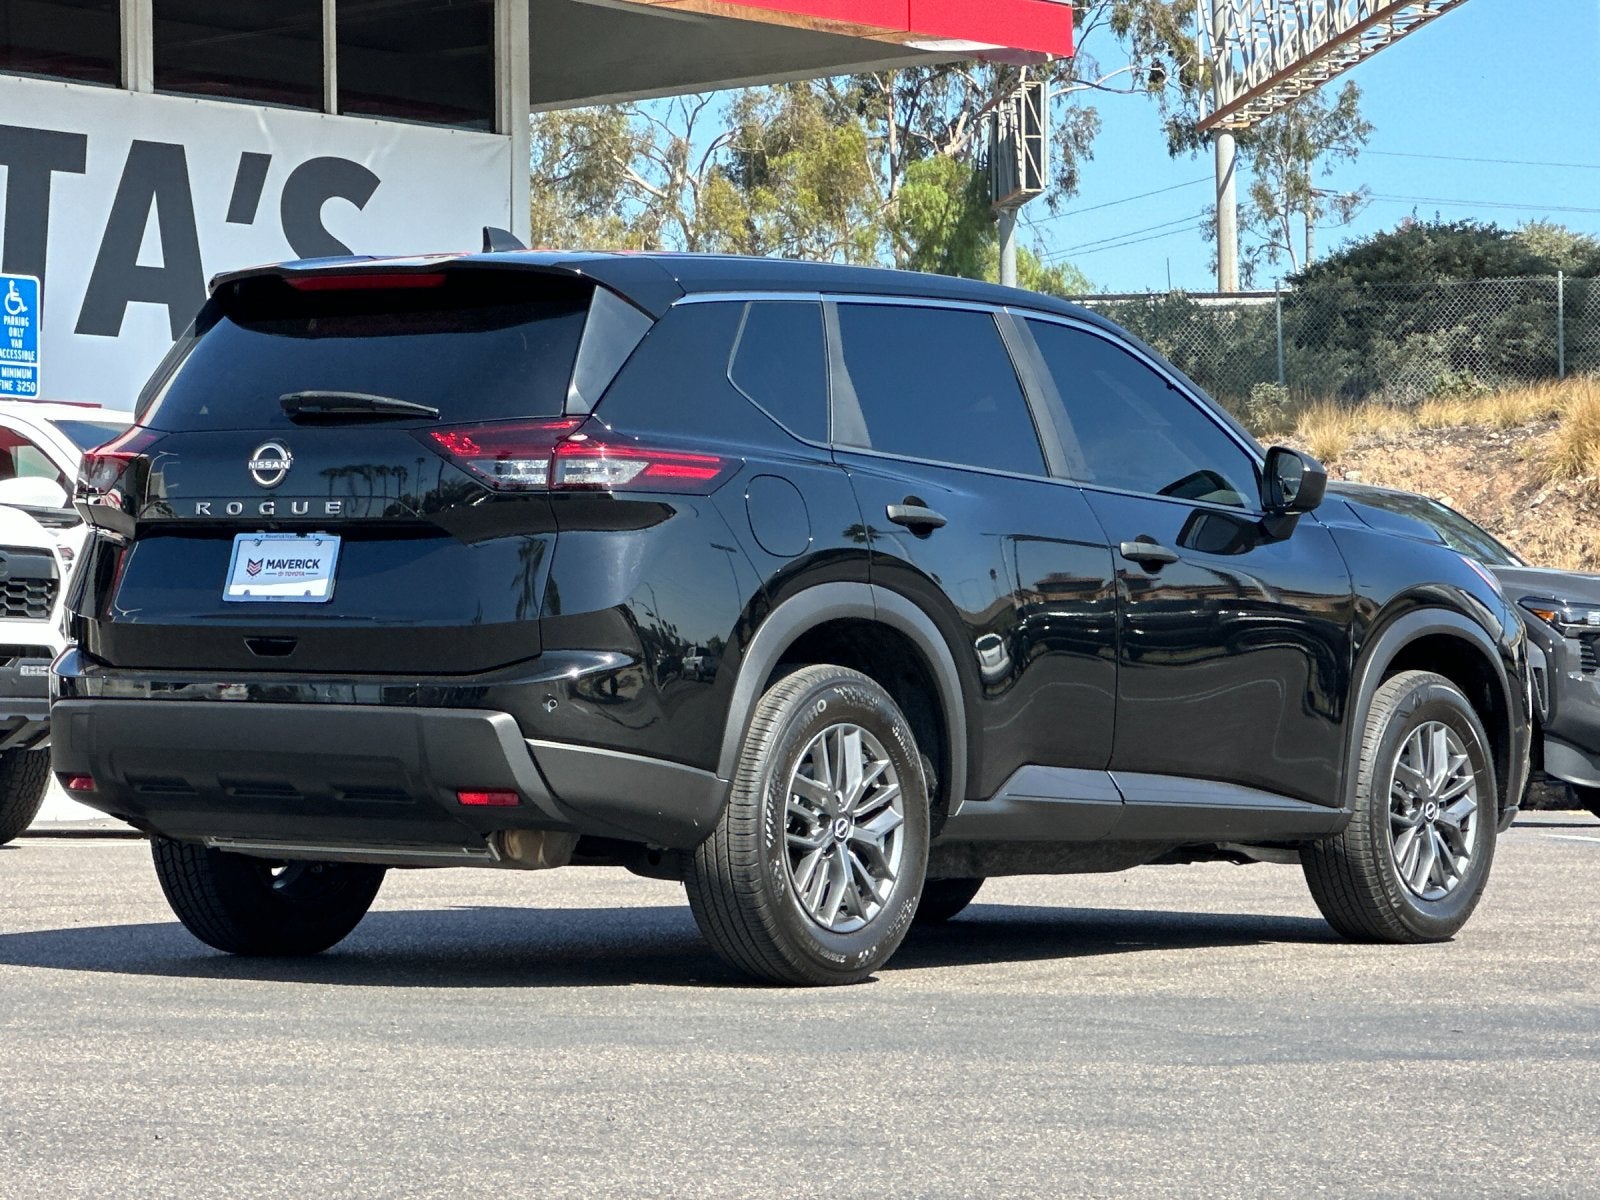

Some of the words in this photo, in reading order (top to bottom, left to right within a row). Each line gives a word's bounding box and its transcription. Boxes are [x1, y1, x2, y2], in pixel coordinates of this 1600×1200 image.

[3, 315, 29, 327] PARKING
[8, 327, 24, 338] ONLY
[11, 338, 23, 349] VAN
[1, 366, 32, 379] MINIMUM
[0, 379, 14, 391] INE
[16, 381, 36, 393] $250
[248, 460, 290, 470] NISSAN
[195, 501, 341, 515] ROGUE
[265, 558, 320, 570] MAVERICK
